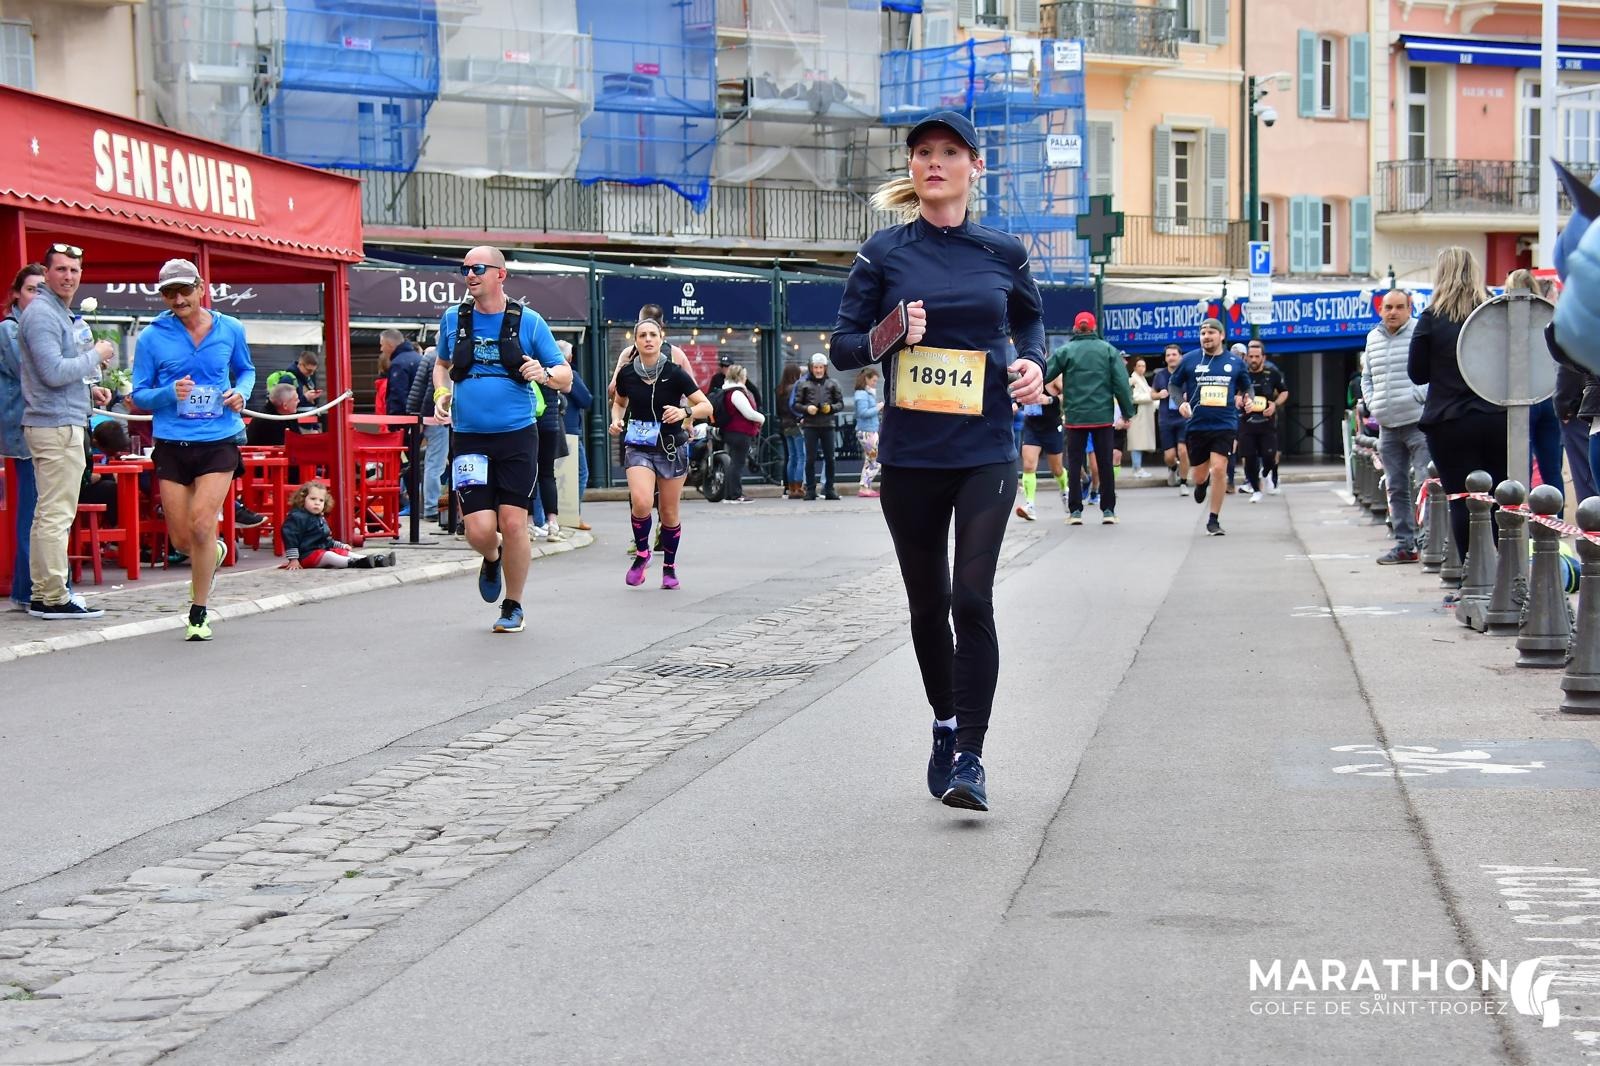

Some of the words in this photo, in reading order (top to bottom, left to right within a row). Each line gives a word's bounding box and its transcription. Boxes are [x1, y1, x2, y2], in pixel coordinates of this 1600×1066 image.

[93, 128, 257, 221] SENEQUIER
[1255, 248, 1266, 270] P
[673, 305, 686, 315] Du
[686, 305, 704, 315] Port
[681, 298, 697, 307] Bar
[1301, 302, 1314, 318] DE
[1102, 307, 1142, 330] VENIRS
[1142, 310, 1154, 326] DE
[909, 365, 973, 388] 18914
[190, 395, 211, 405] 517
